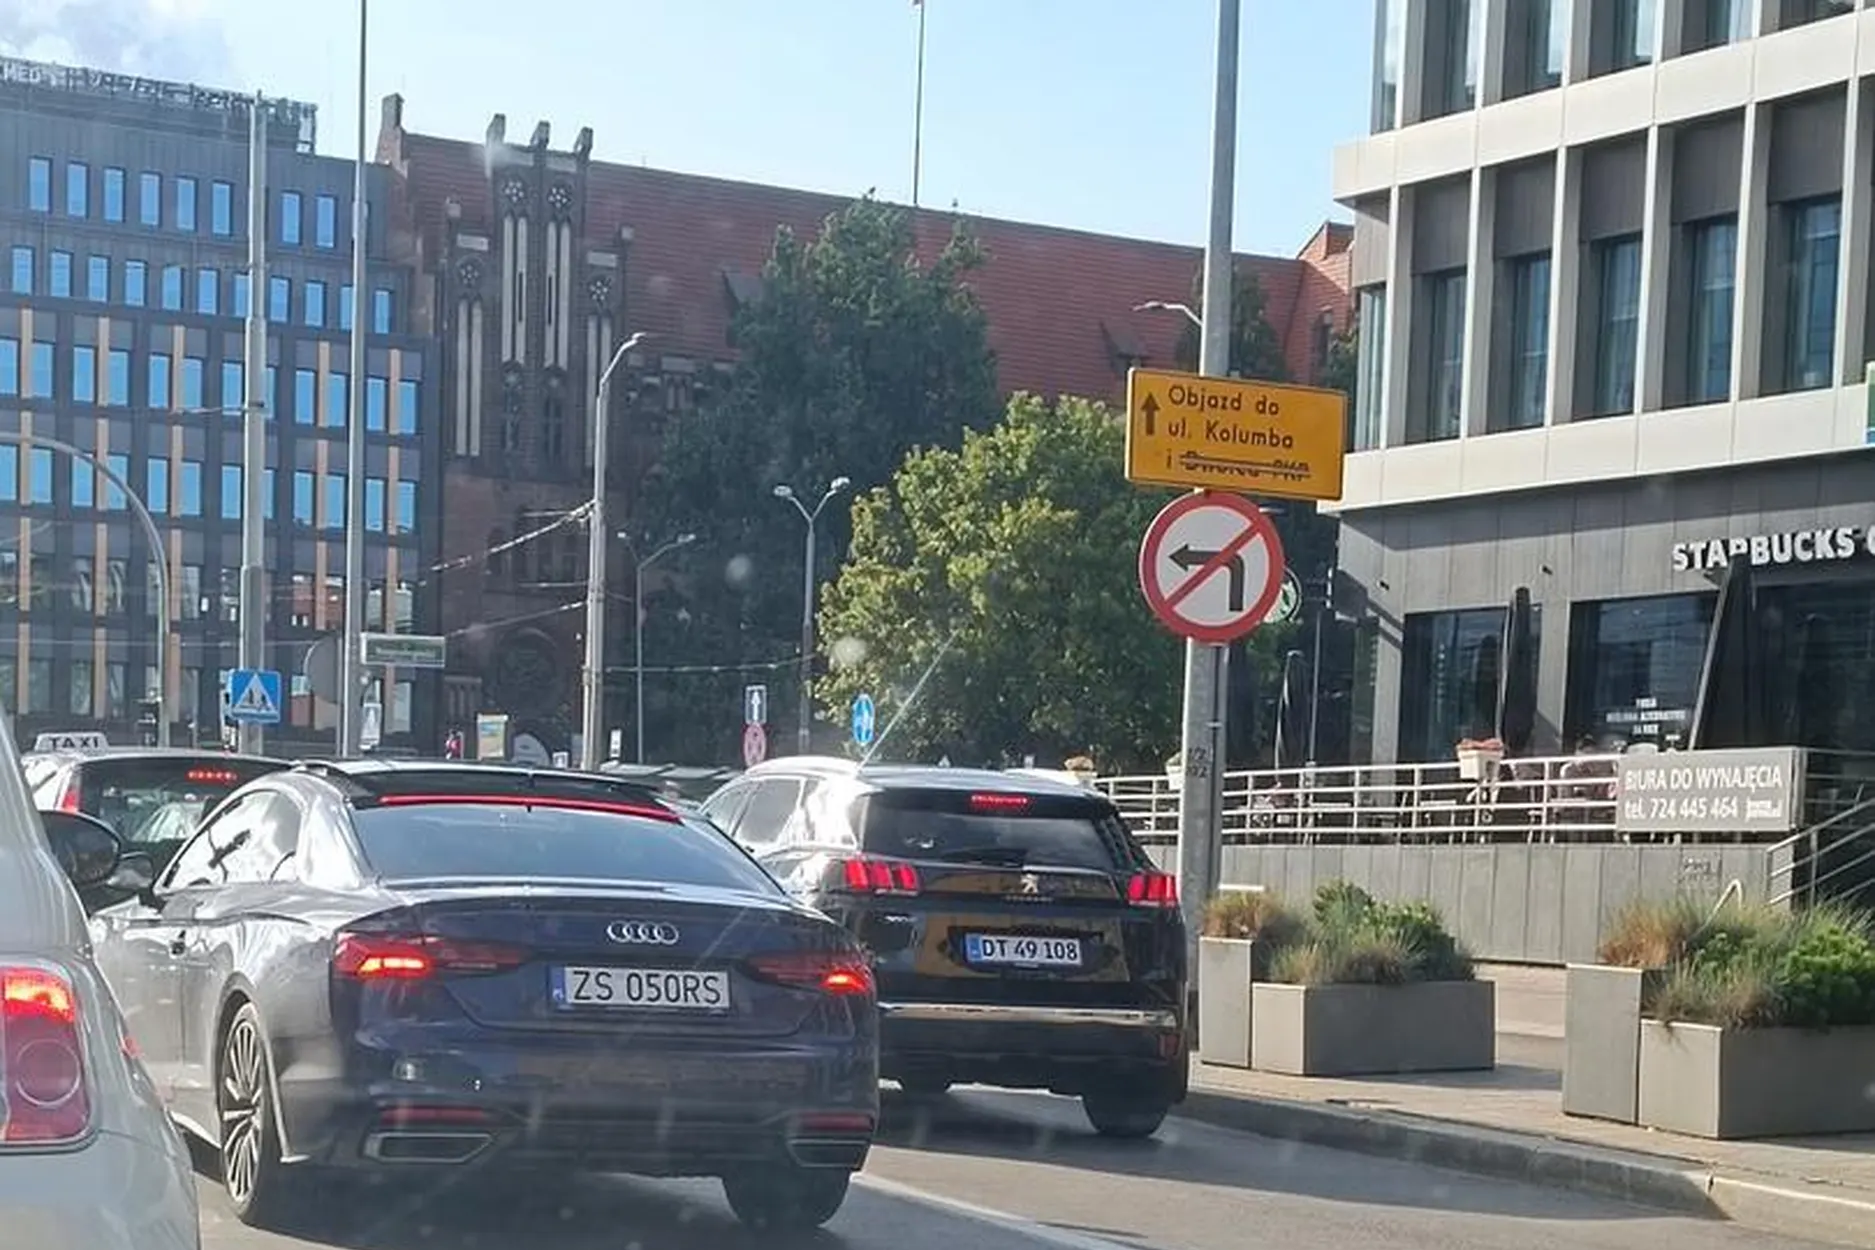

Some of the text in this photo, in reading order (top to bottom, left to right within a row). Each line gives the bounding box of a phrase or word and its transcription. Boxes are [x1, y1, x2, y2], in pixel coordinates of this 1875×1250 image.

[1168, 384, 1280, 415] Objazd do
[1168, 417, 1294, 448] ul. Kolumba
[50, 737, 99, 748] TAXI
[1624, 765, 1783, 793] BIURA DO WYNAJĘCIA
[1650, 797, 1677, 819] 724
[1680, 796, 1709, 818] 445
[982, 939, 1078, 960] DT 49 108
[573, 970, 721, 1005] ZS 050RS
